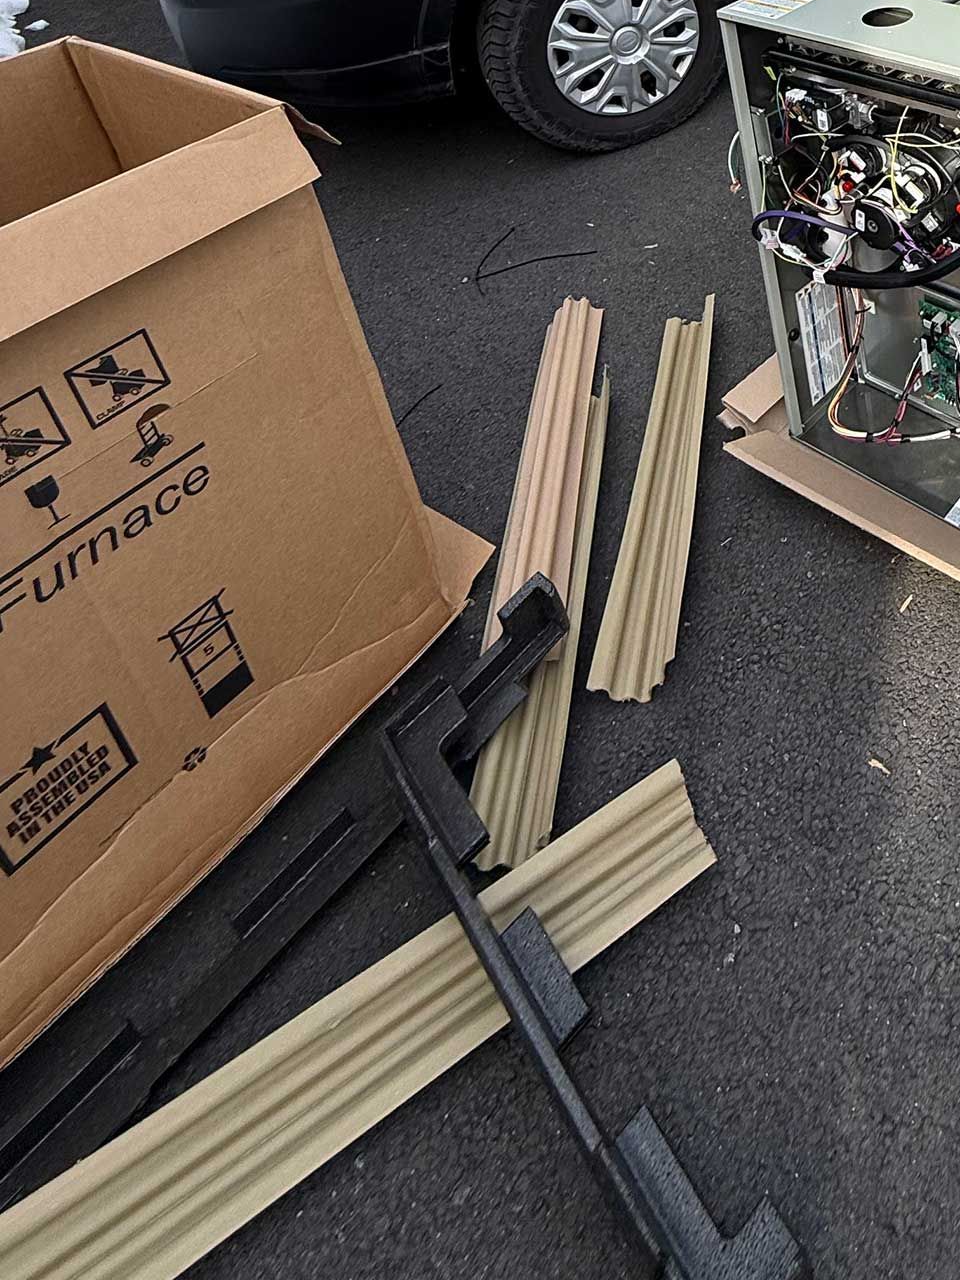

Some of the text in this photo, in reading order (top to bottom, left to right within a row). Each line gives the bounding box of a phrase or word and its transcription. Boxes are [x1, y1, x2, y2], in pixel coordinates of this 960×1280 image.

[6, 744, 109, 838] ASSEMBLED
[10, 741, 90, 815] PROUDLY
[18, 760, 112, 844] IN THE USA
